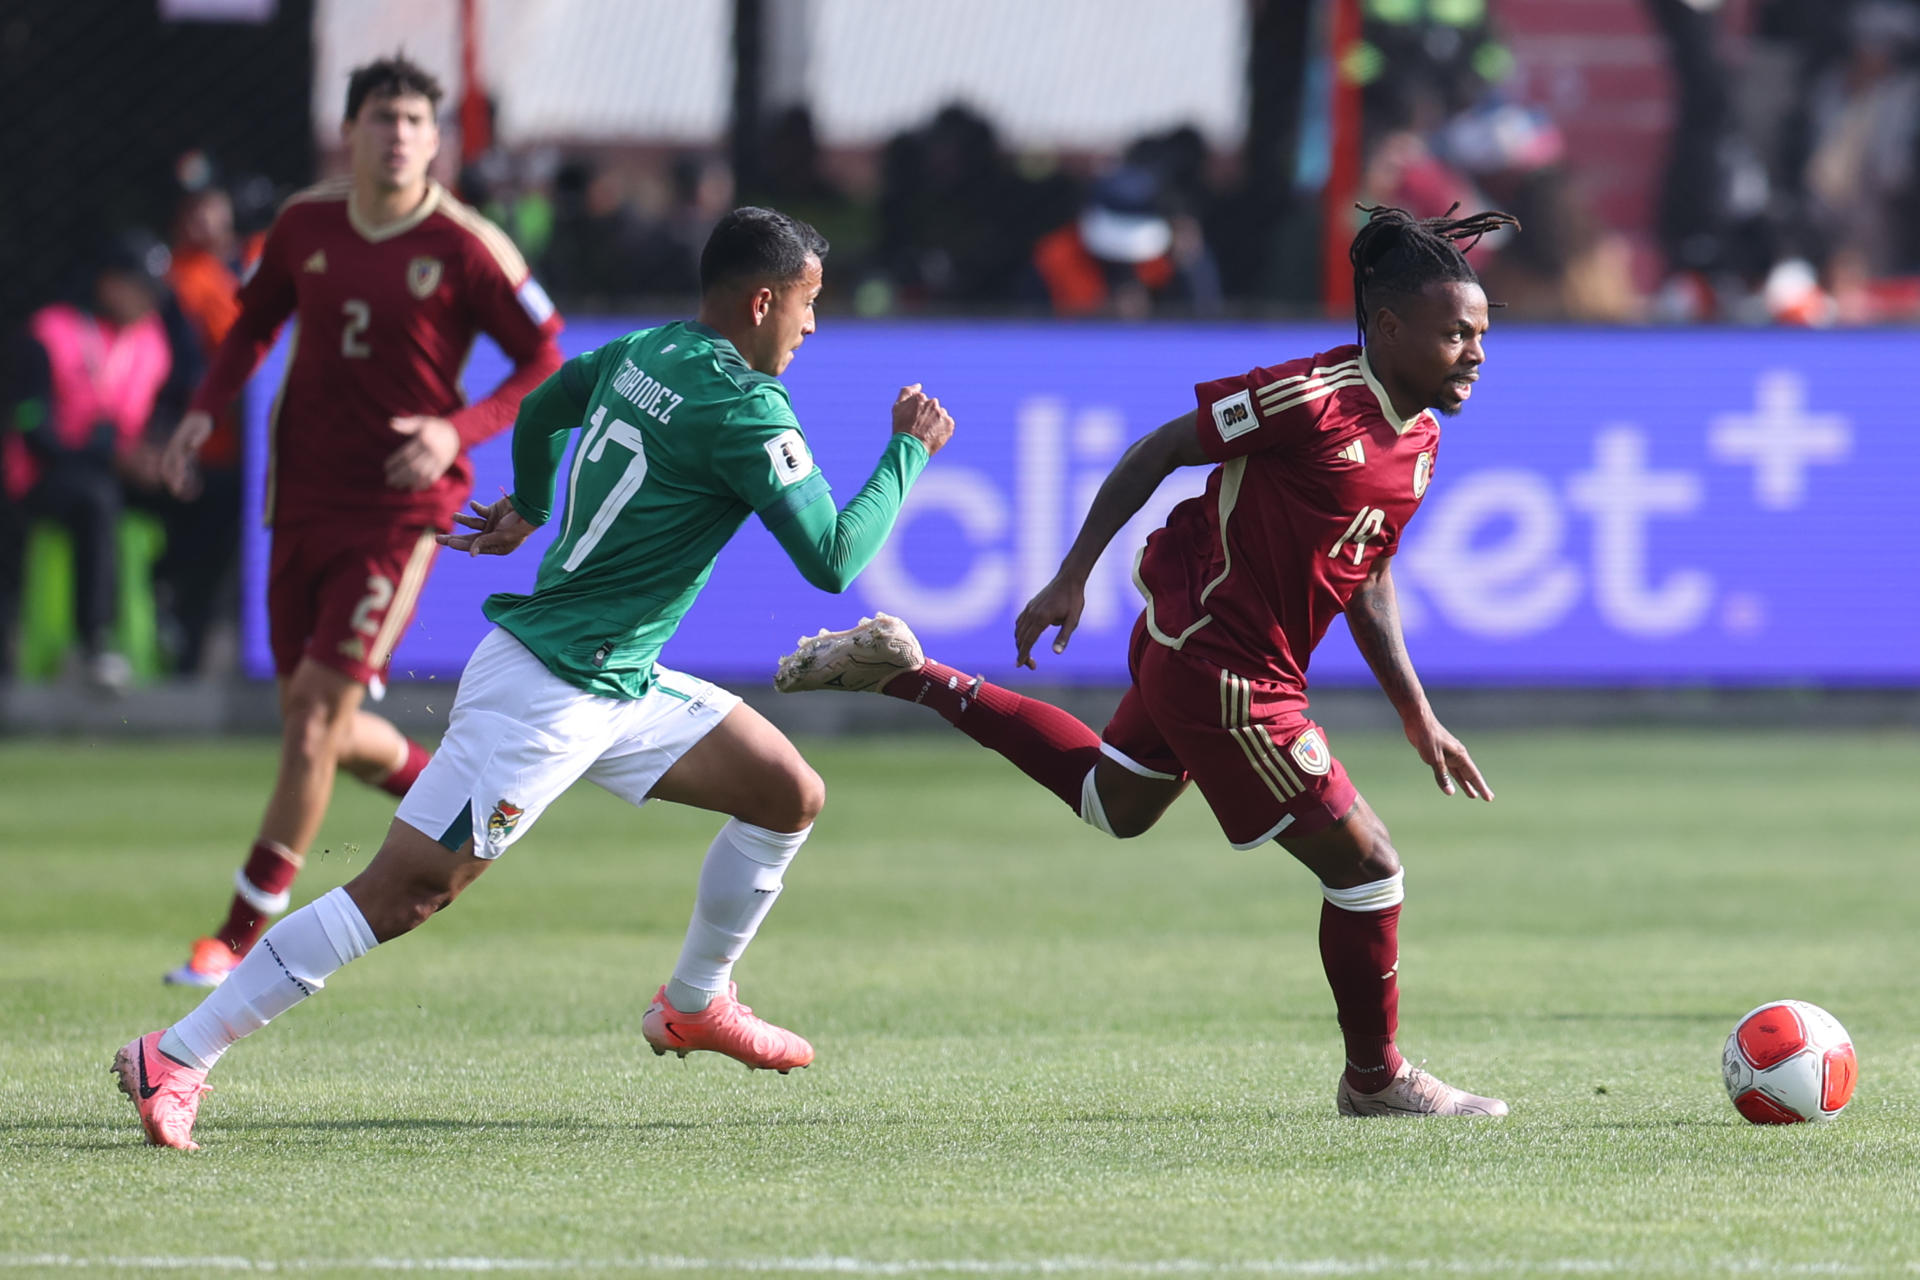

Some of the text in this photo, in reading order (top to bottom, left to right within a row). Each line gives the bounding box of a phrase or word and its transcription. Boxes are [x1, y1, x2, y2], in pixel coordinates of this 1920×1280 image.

[342, 299, 371, 358] 2
[555, 404, 649, 573] 17
[1328, 505, 1386, 566] 19
[350, 574, 395, 637] 2
